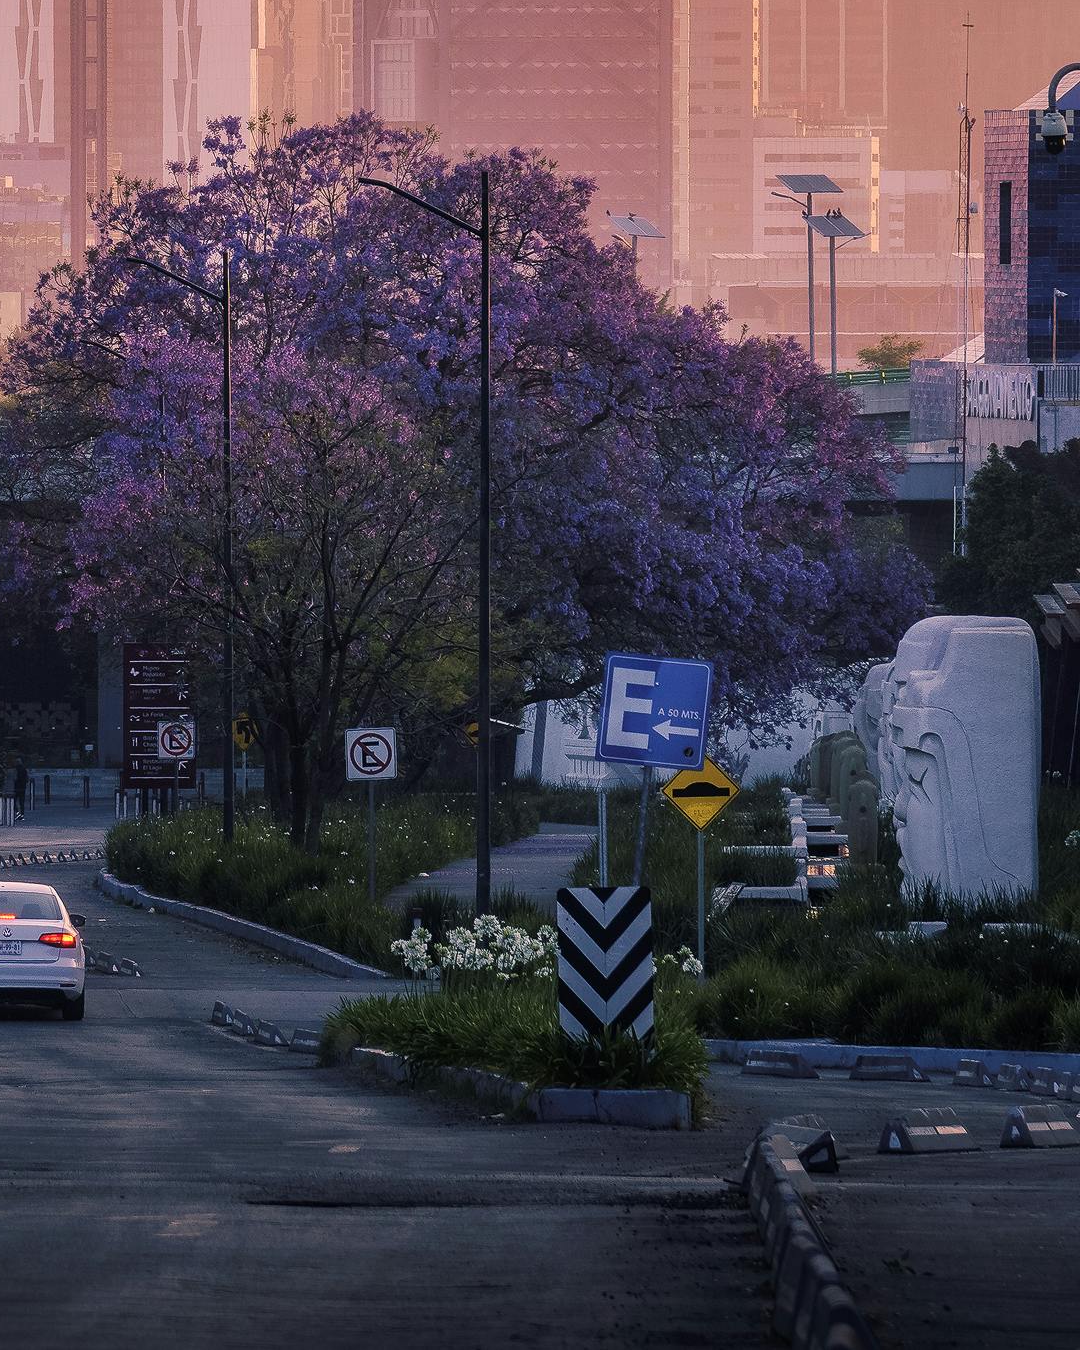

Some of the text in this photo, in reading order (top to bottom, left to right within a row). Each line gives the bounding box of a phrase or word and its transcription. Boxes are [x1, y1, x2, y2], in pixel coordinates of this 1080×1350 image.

[606, 666, 656, 750] E
[657, 707, 701, 720] A 50 MTS.
